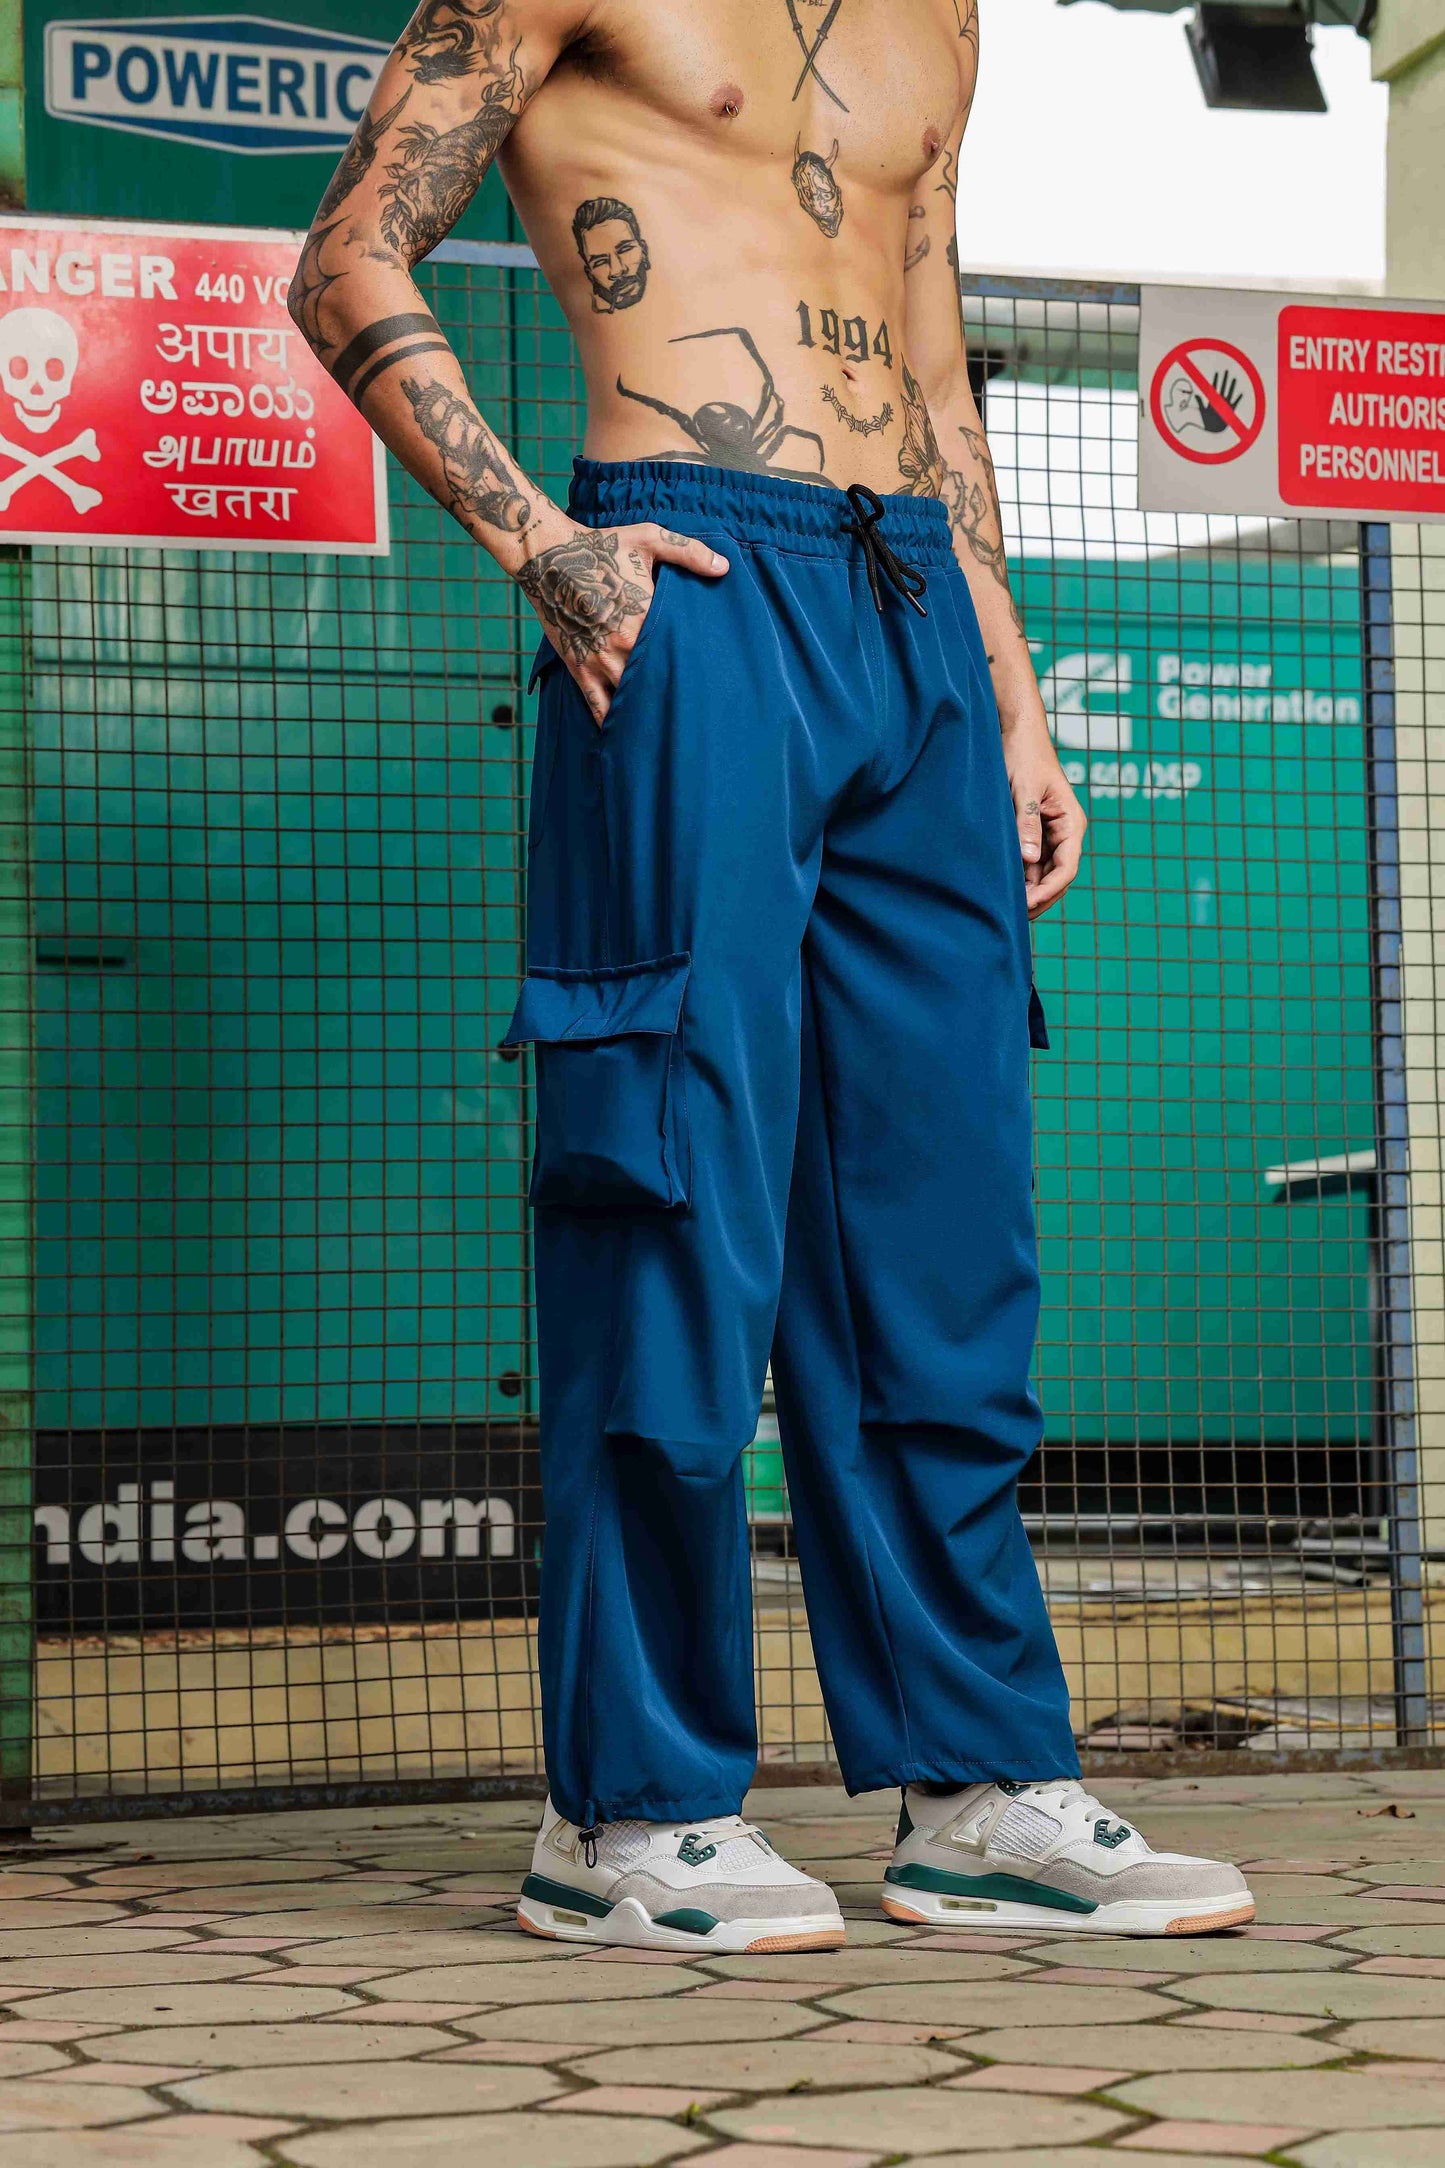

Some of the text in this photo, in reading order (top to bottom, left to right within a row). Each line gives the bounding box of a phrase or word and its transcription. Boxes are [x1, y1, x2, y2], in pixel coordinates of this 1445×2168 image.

[71, 41, 372, 122] POWERIC
[0, 248, 178, 301] NGER
[194, 272, 245, 304] 440
[155, 323, 295, 371] अपाय
[796, 299, 893, 370] 1994
[1289, 335, 1371, 373] ENTRY
[140, 377, 315, 420] ಅಪಾಯ
[142, 427, 317, 472] அபாயம்
[1300, 443, 1445, 484] PERSONNEL
[163, 482, 299, 521] खतरा
[1157, 654, 1272, 689] Power
[1156, 684, 1361, 724] Generation
[33, 1480, 515, 1566] ndia.com
